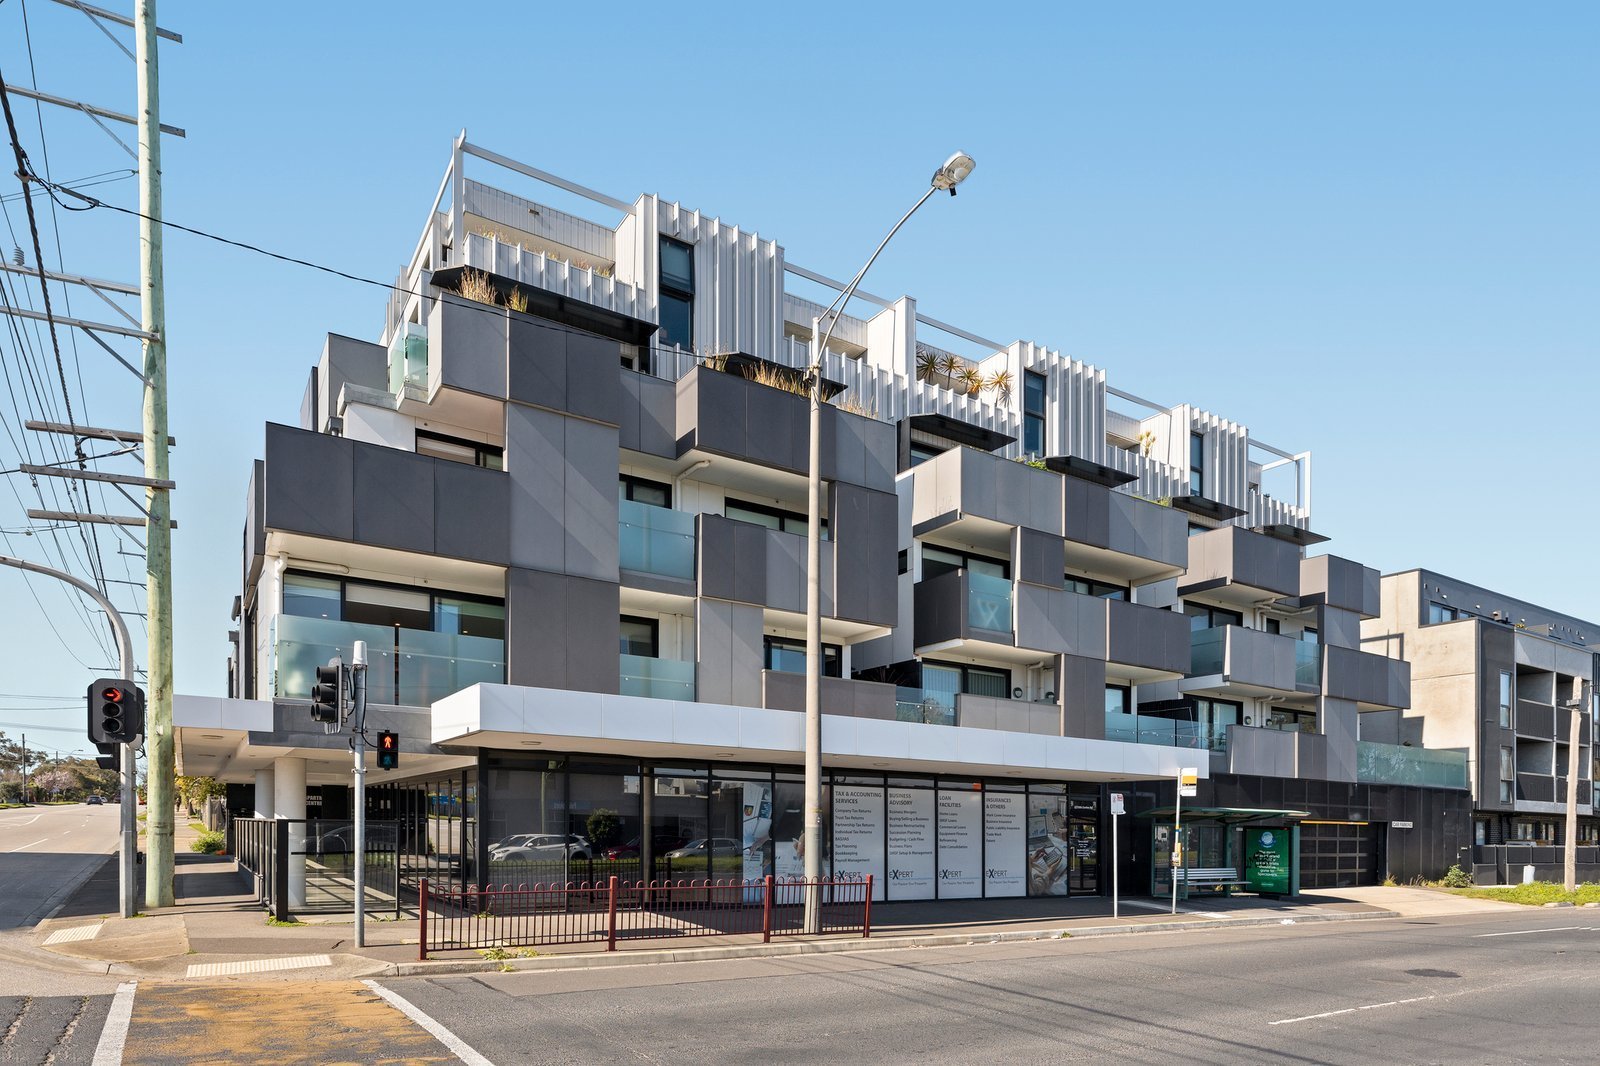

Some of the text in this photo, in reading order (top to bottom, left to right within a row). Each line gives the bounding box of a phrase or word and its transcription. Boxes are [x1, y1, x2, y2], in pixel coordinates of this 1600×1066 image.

[889, 869, 914, 880] EXPERT
[939, 869, 963, 880] EXPERT
[986, 868, 1008, 879] EXPERT
